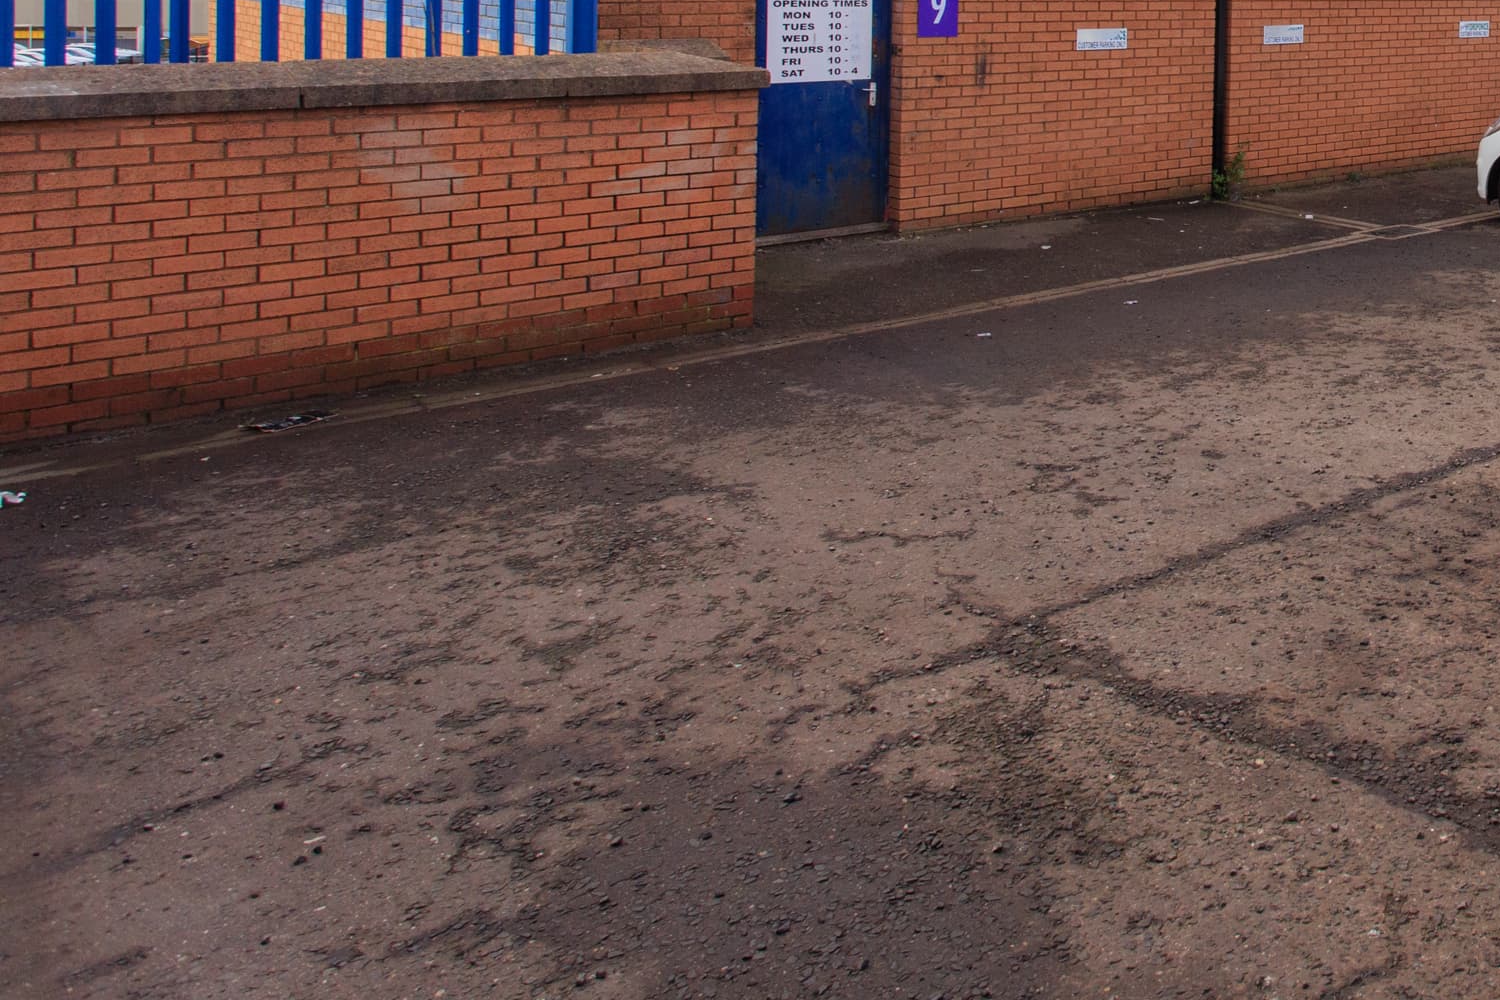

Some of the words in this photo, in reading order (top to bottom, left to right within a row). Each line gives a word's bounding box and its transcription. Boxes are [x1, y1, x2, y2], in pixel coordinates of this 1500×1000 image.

[773, 0, 829, 8] OPENING
[832, 0, 868, 8] TIMES
[828, 11, 842, 19] 10
[782, 23, 815, 31] TUES
[828, 22, 842, 30] 10
[782, 46, 824, 54] THURS
[828, 45, 842, 53] 10
[782, 58, 801, 66] FRI
